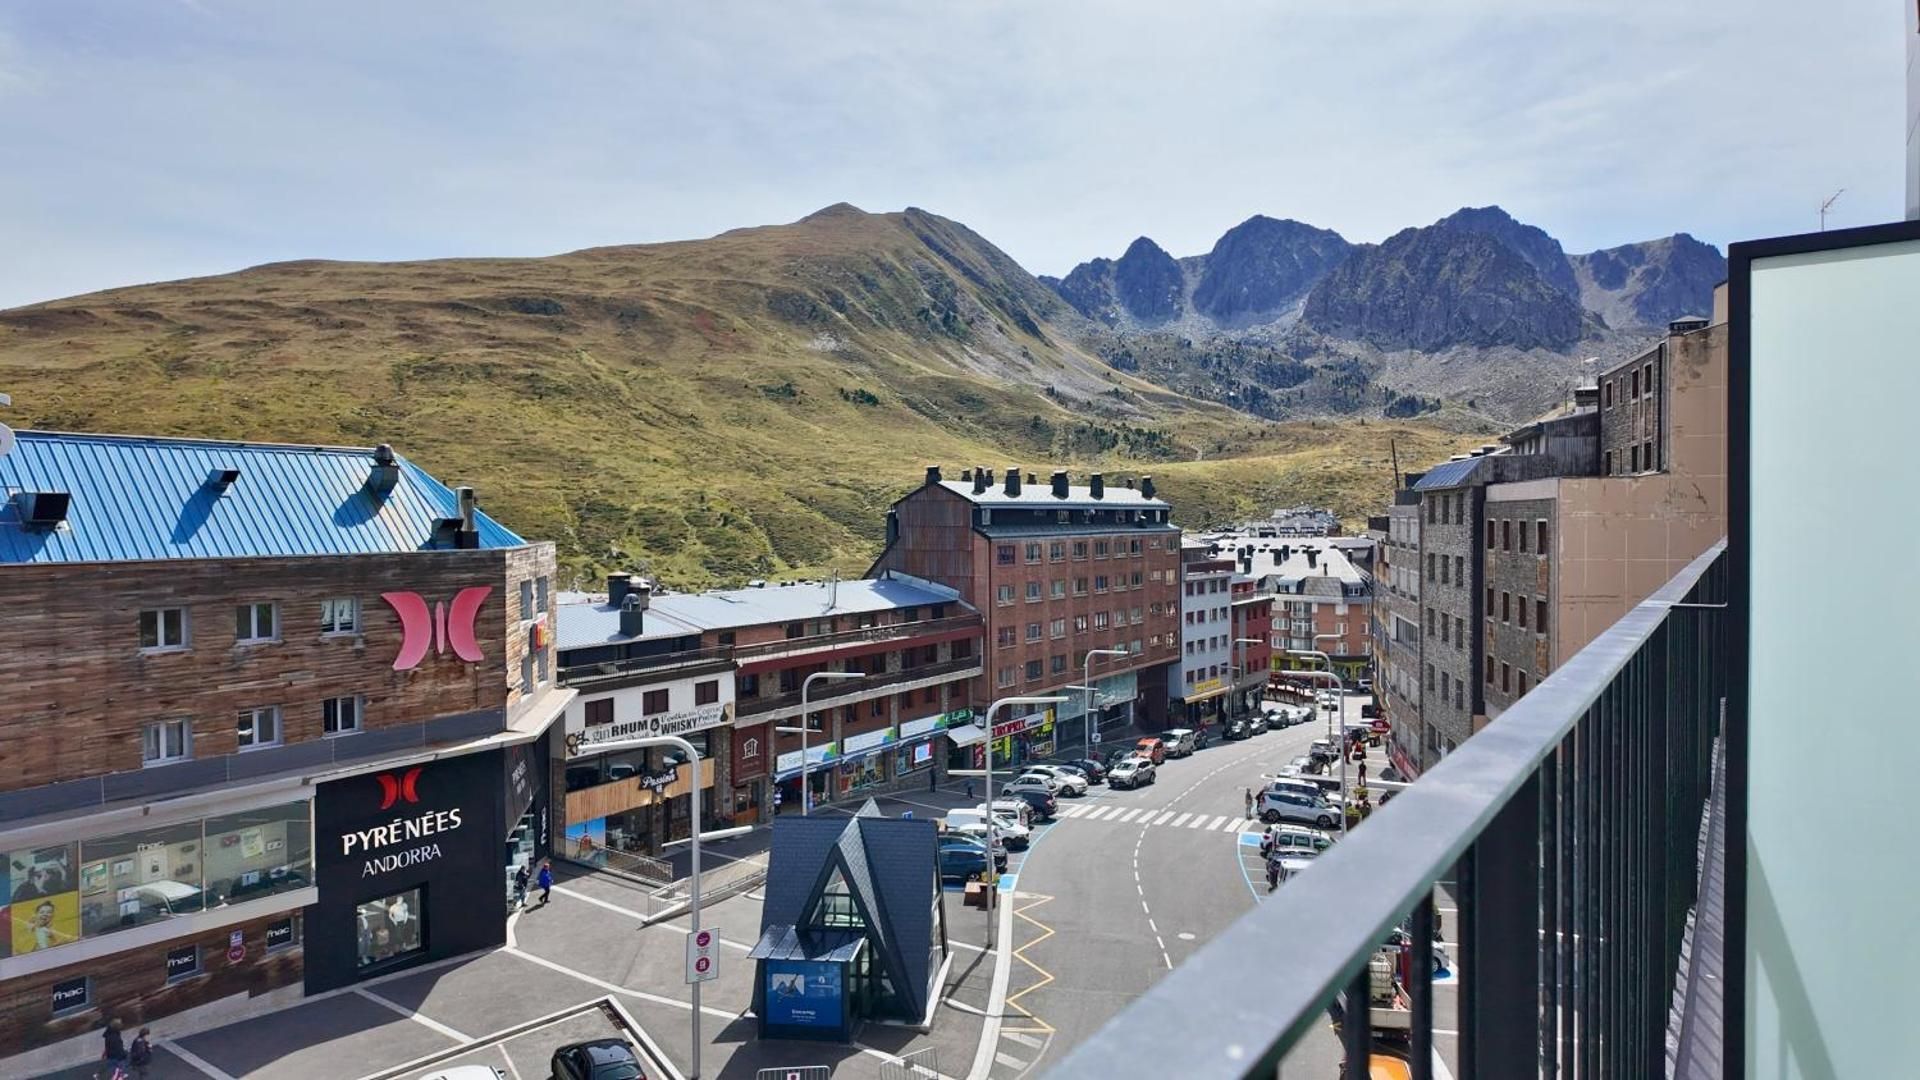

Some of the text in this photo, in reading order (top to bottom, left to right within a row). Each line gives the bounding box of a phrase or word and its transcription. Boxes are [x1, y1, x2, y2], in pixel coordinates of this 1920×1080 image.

[611, 719, 648, 737] RHUM
[661, 717, 697, 735] WHISKY
[341, 807, 462, 855] PYRÉNÉES
[361, 843, 442, 878] ANDORRA
[267, 927, 290, 939] fnac
[168, 954, 194, 968] fnac
[53, 986, 85, 1001] fnac
